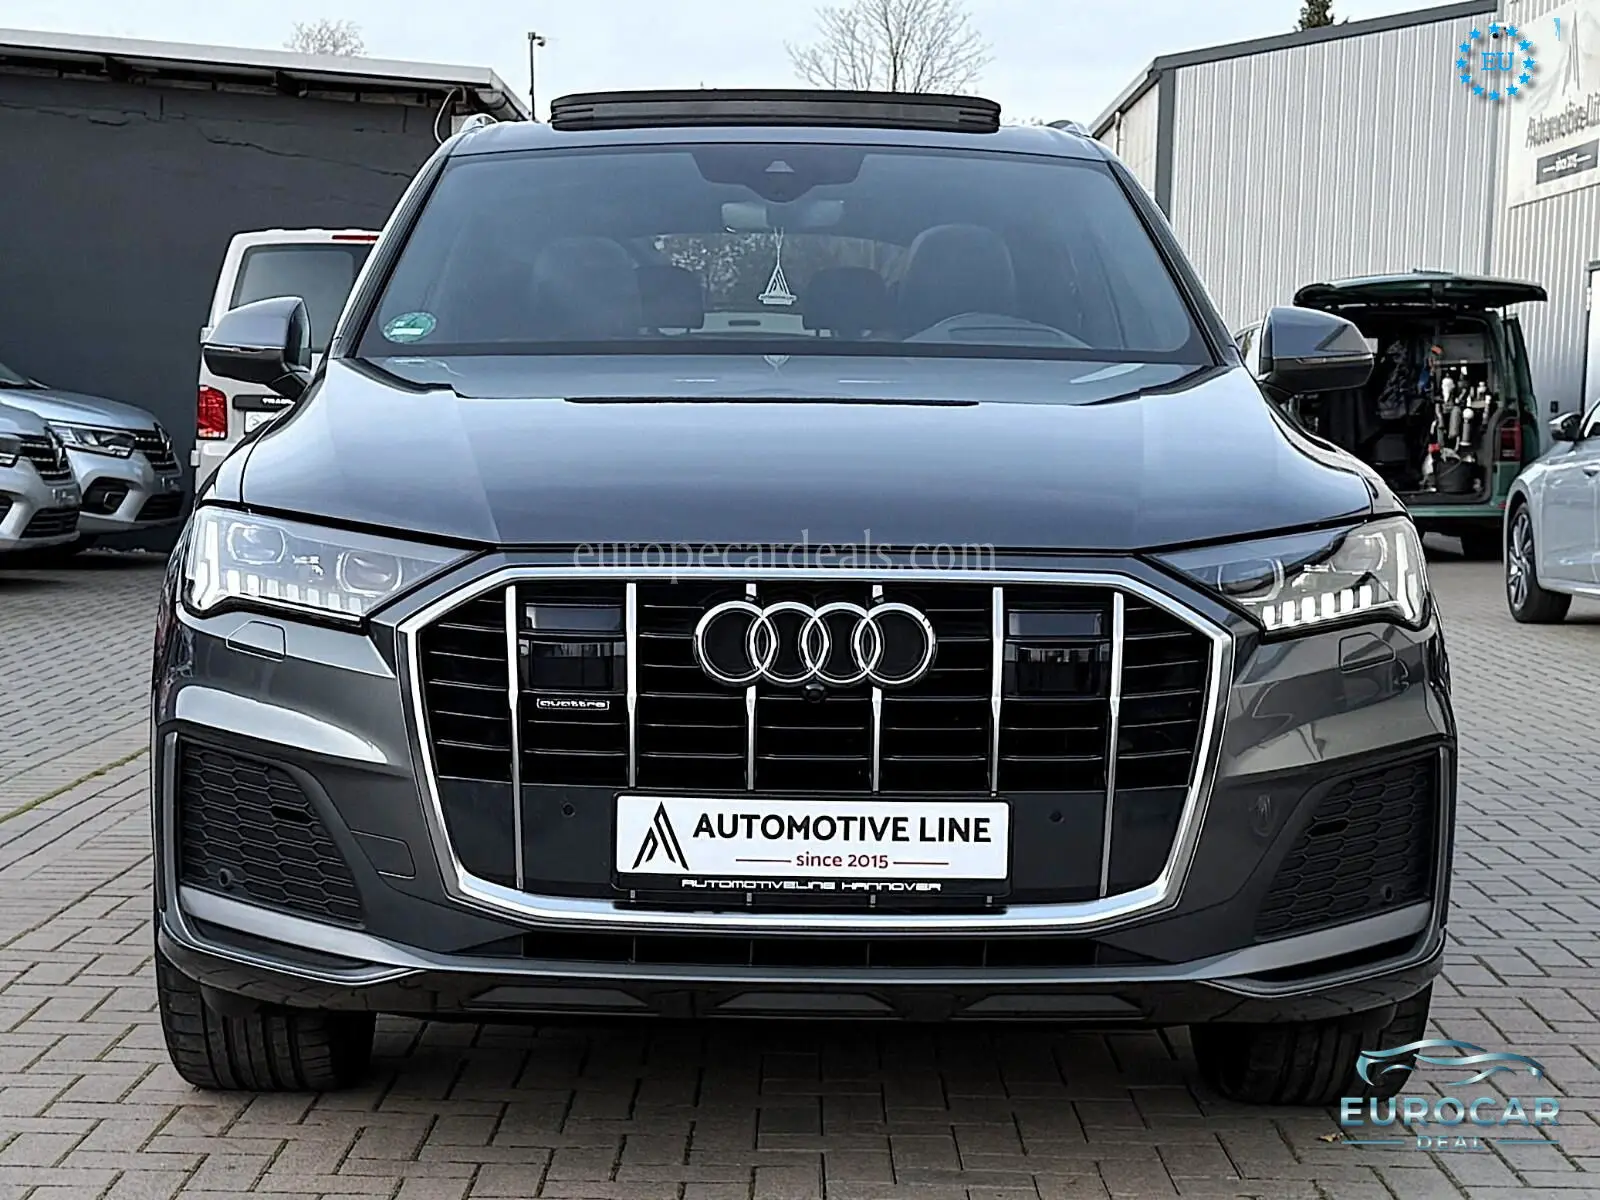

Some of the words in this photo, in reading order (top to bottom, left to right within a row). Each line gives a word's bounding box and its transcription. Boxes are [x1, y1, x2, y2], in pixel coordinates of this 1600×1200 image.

[539, 699, 607, 709] quattro
[693, 813, 909, 842] AUTOMOTIVE
[919, 817, 991, 842] LINE
[796, 851, 842, 867] since
[848, 854, 889, 869] 2015
